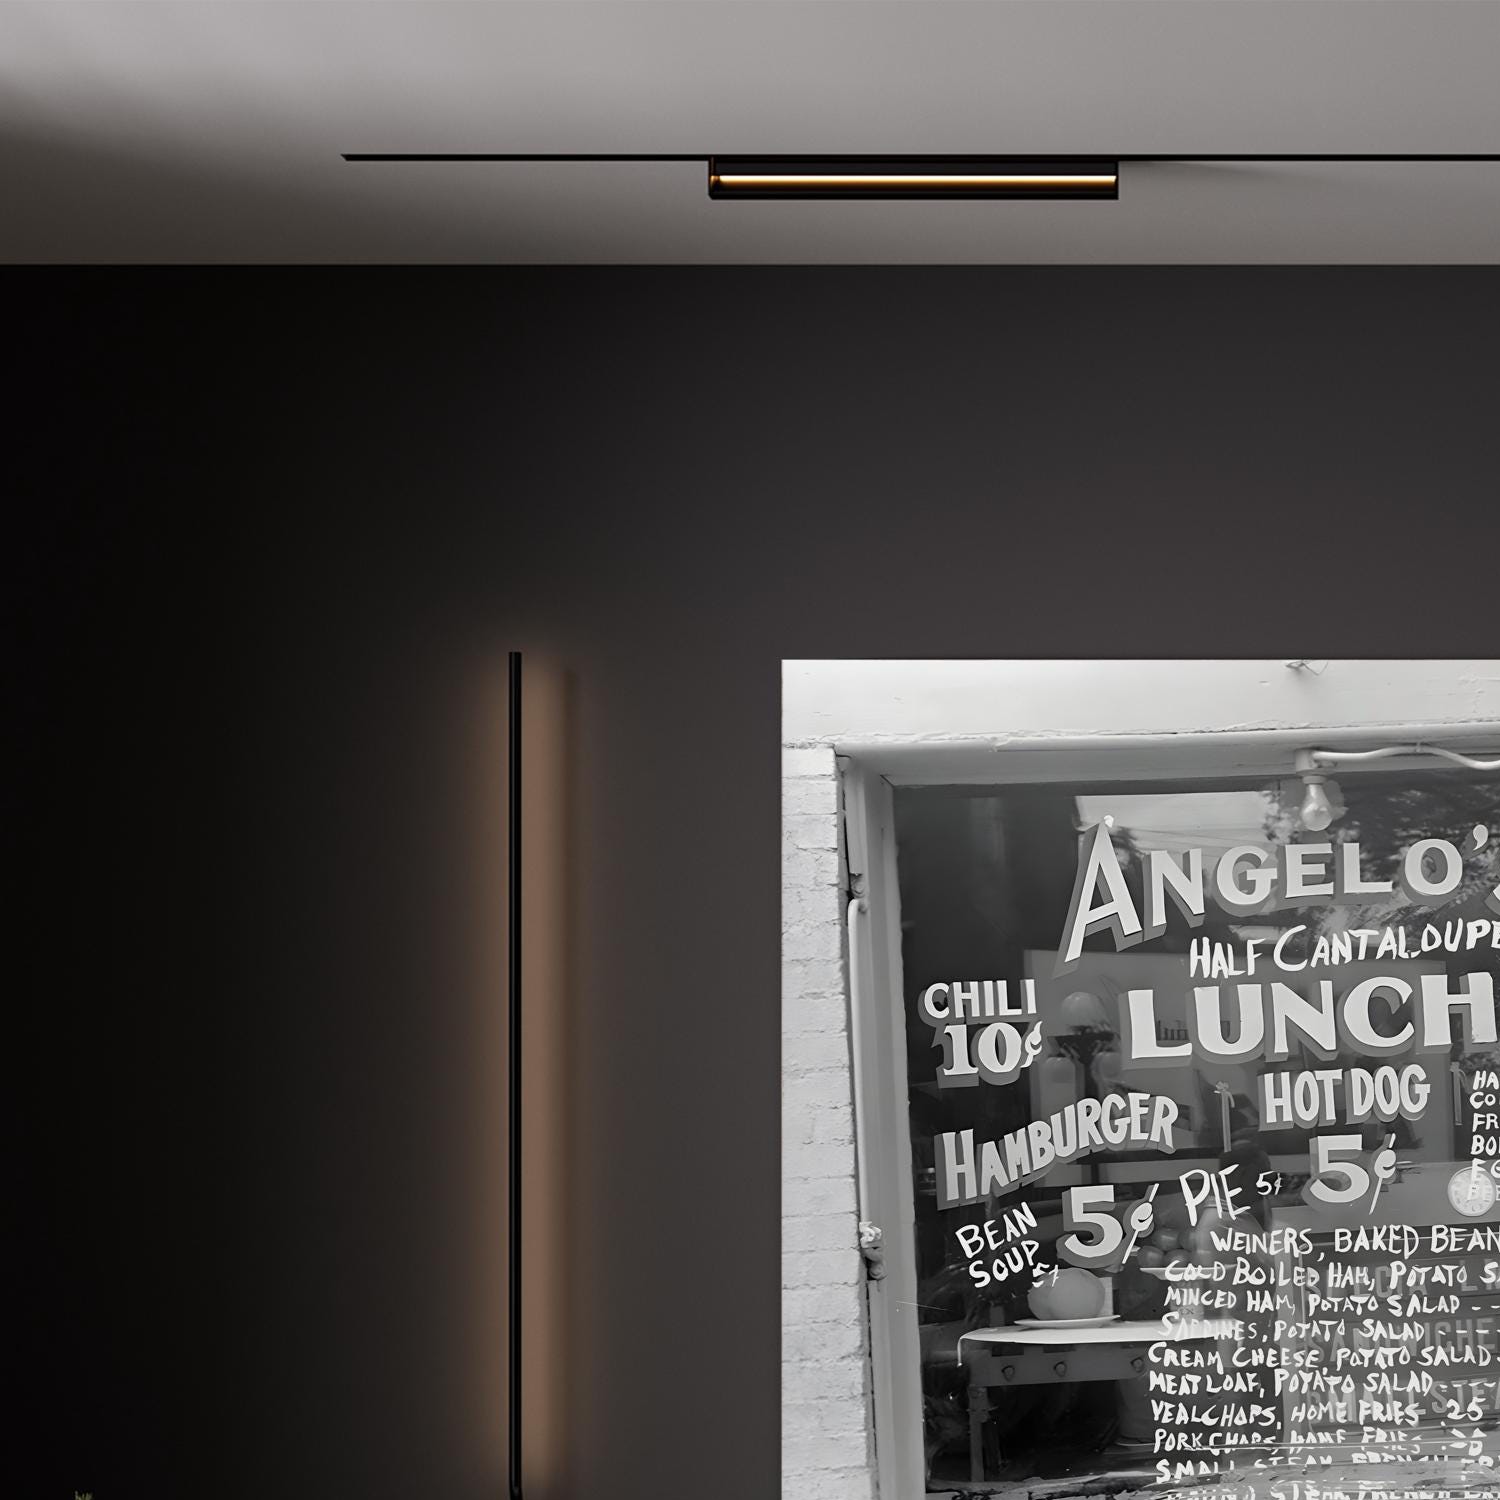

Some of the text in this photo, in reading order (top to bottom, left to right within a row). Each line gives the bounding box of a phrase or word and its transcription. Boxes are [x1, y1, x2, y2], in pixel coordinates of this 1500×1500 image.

[1190, 936, 1266, 977] HALF
[921, 979, 1037, 1020] CHILI
[1125, 971, 1498, 1061] LUNCH
[939, 1020, 1043, 1079] 10¢
[1260, 1063, 1431, 1125] HOT DOG
[939, 1092, 1178, 1206] HAMBURGER
[1179, 1163, 1251, 1226] PIE
[955, 1202, 1038, 1259] BEAN
[1334, 1224, 1420, 1259] BAKED
[968, 1239, 1040, 1288] SOUP
[1164, 1259, 1226, 1282] COLD
[1232, 1257, 1320, 1288] BOILED
[1389, 1260, 1468, 1290] POTATO
[1163, 1286, 1237, 1309] MINCED
[1308, 1294, 1379, 1316] POTATO
[1387, 1294, 1460, 1317] SALAD
[1274, 1320, 1346, 1342] POTATO
[1360, 1318, 1425, 1342] SALAD
[1149, 1341, 1225, 1377] CREAM
[1336, 1345, 1410, 1370] POTATO
[1416, 1345, 1491, 1367] SALAD
[1149, 1370, 1201, 1396] MEAT
[1274, 1368, 1355, 1396] POTATO
[1363, 1371, 1433, 1397] SALAD
[1290, 1402, 1348, 1423] HOME
[1358, 1399, 1422, 1427] FRIES
[1153, 1428, 1203, 1453] PORK
